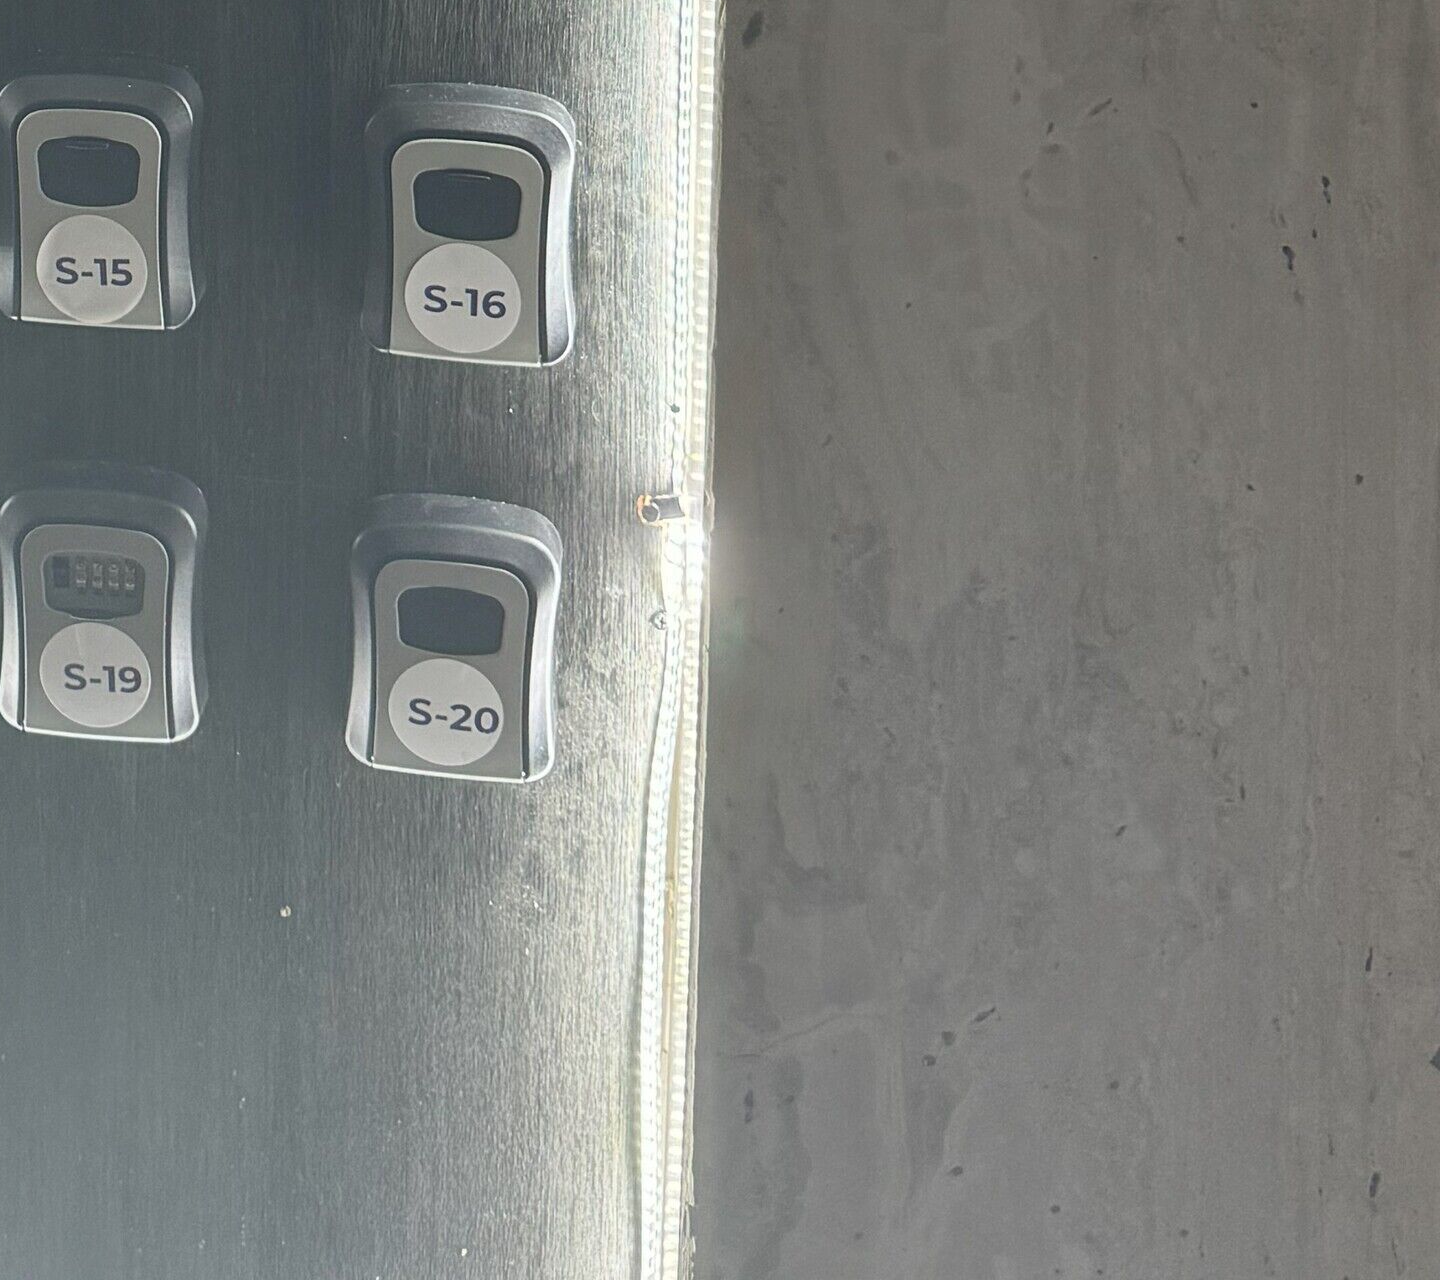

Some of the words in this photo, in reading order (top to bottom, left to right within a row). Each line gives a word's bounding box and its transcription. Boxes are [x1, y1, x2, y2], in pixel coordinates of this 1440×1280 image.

[55, 256, 133, 287] S-15
[423, 284, 507, 319] S-16
[63, 663, 142, 694] S-19
[408, 698, 500, 735] S-20
